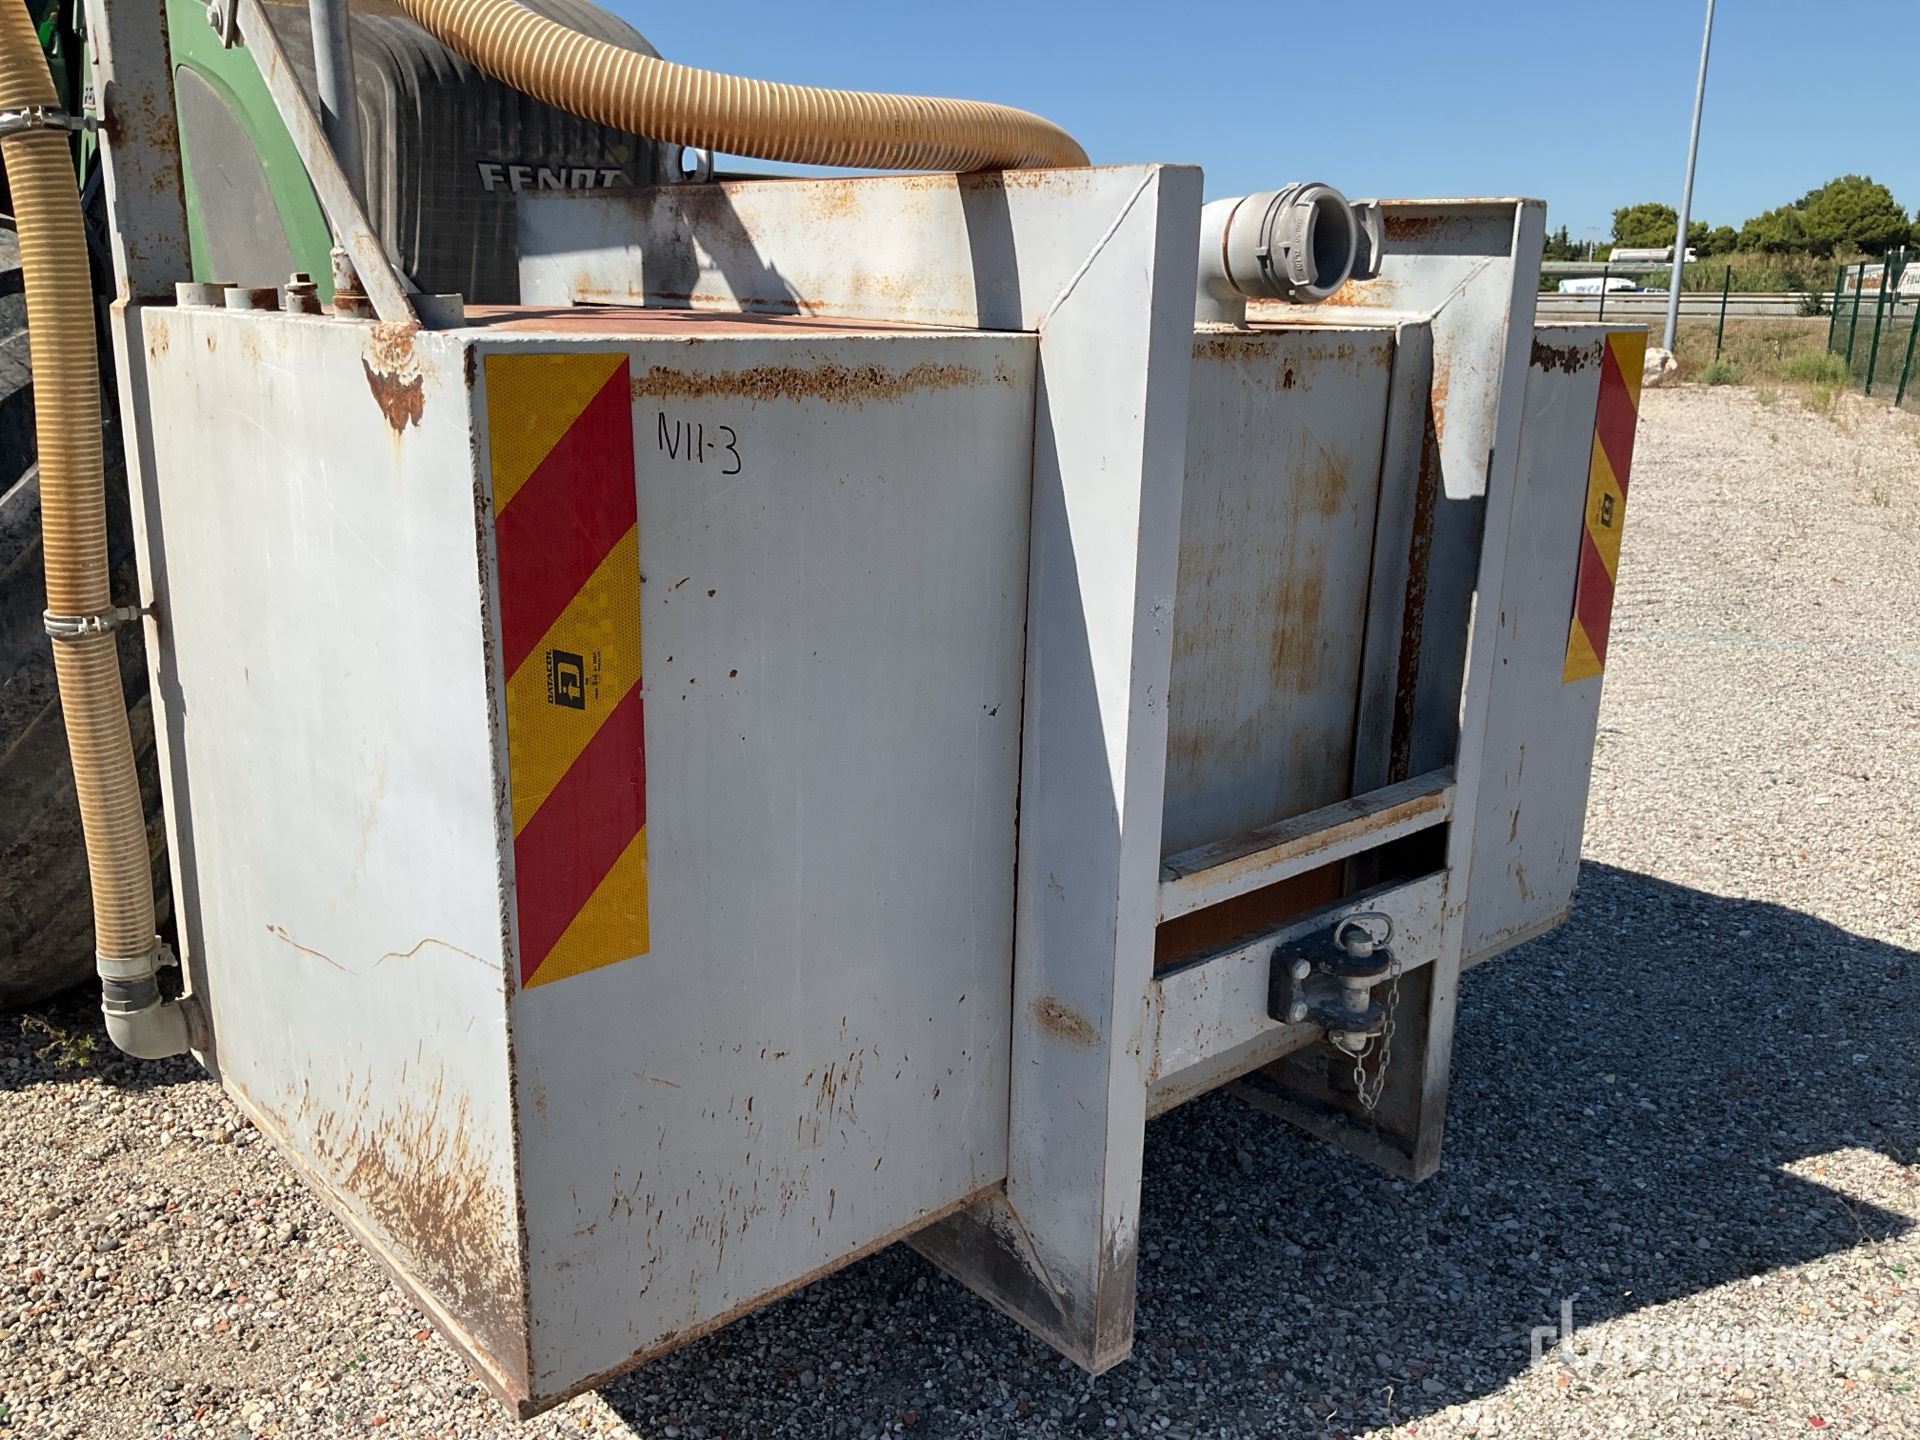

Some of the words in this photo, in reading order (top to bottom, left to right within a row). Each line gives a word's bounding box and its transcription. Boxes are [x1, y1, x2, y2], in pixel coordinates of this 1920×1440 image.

[477, 162, 622, 192] FENDT
[1906, 274, 1920, 284] FRU
[545, 648, 553, 704] DATACOL
